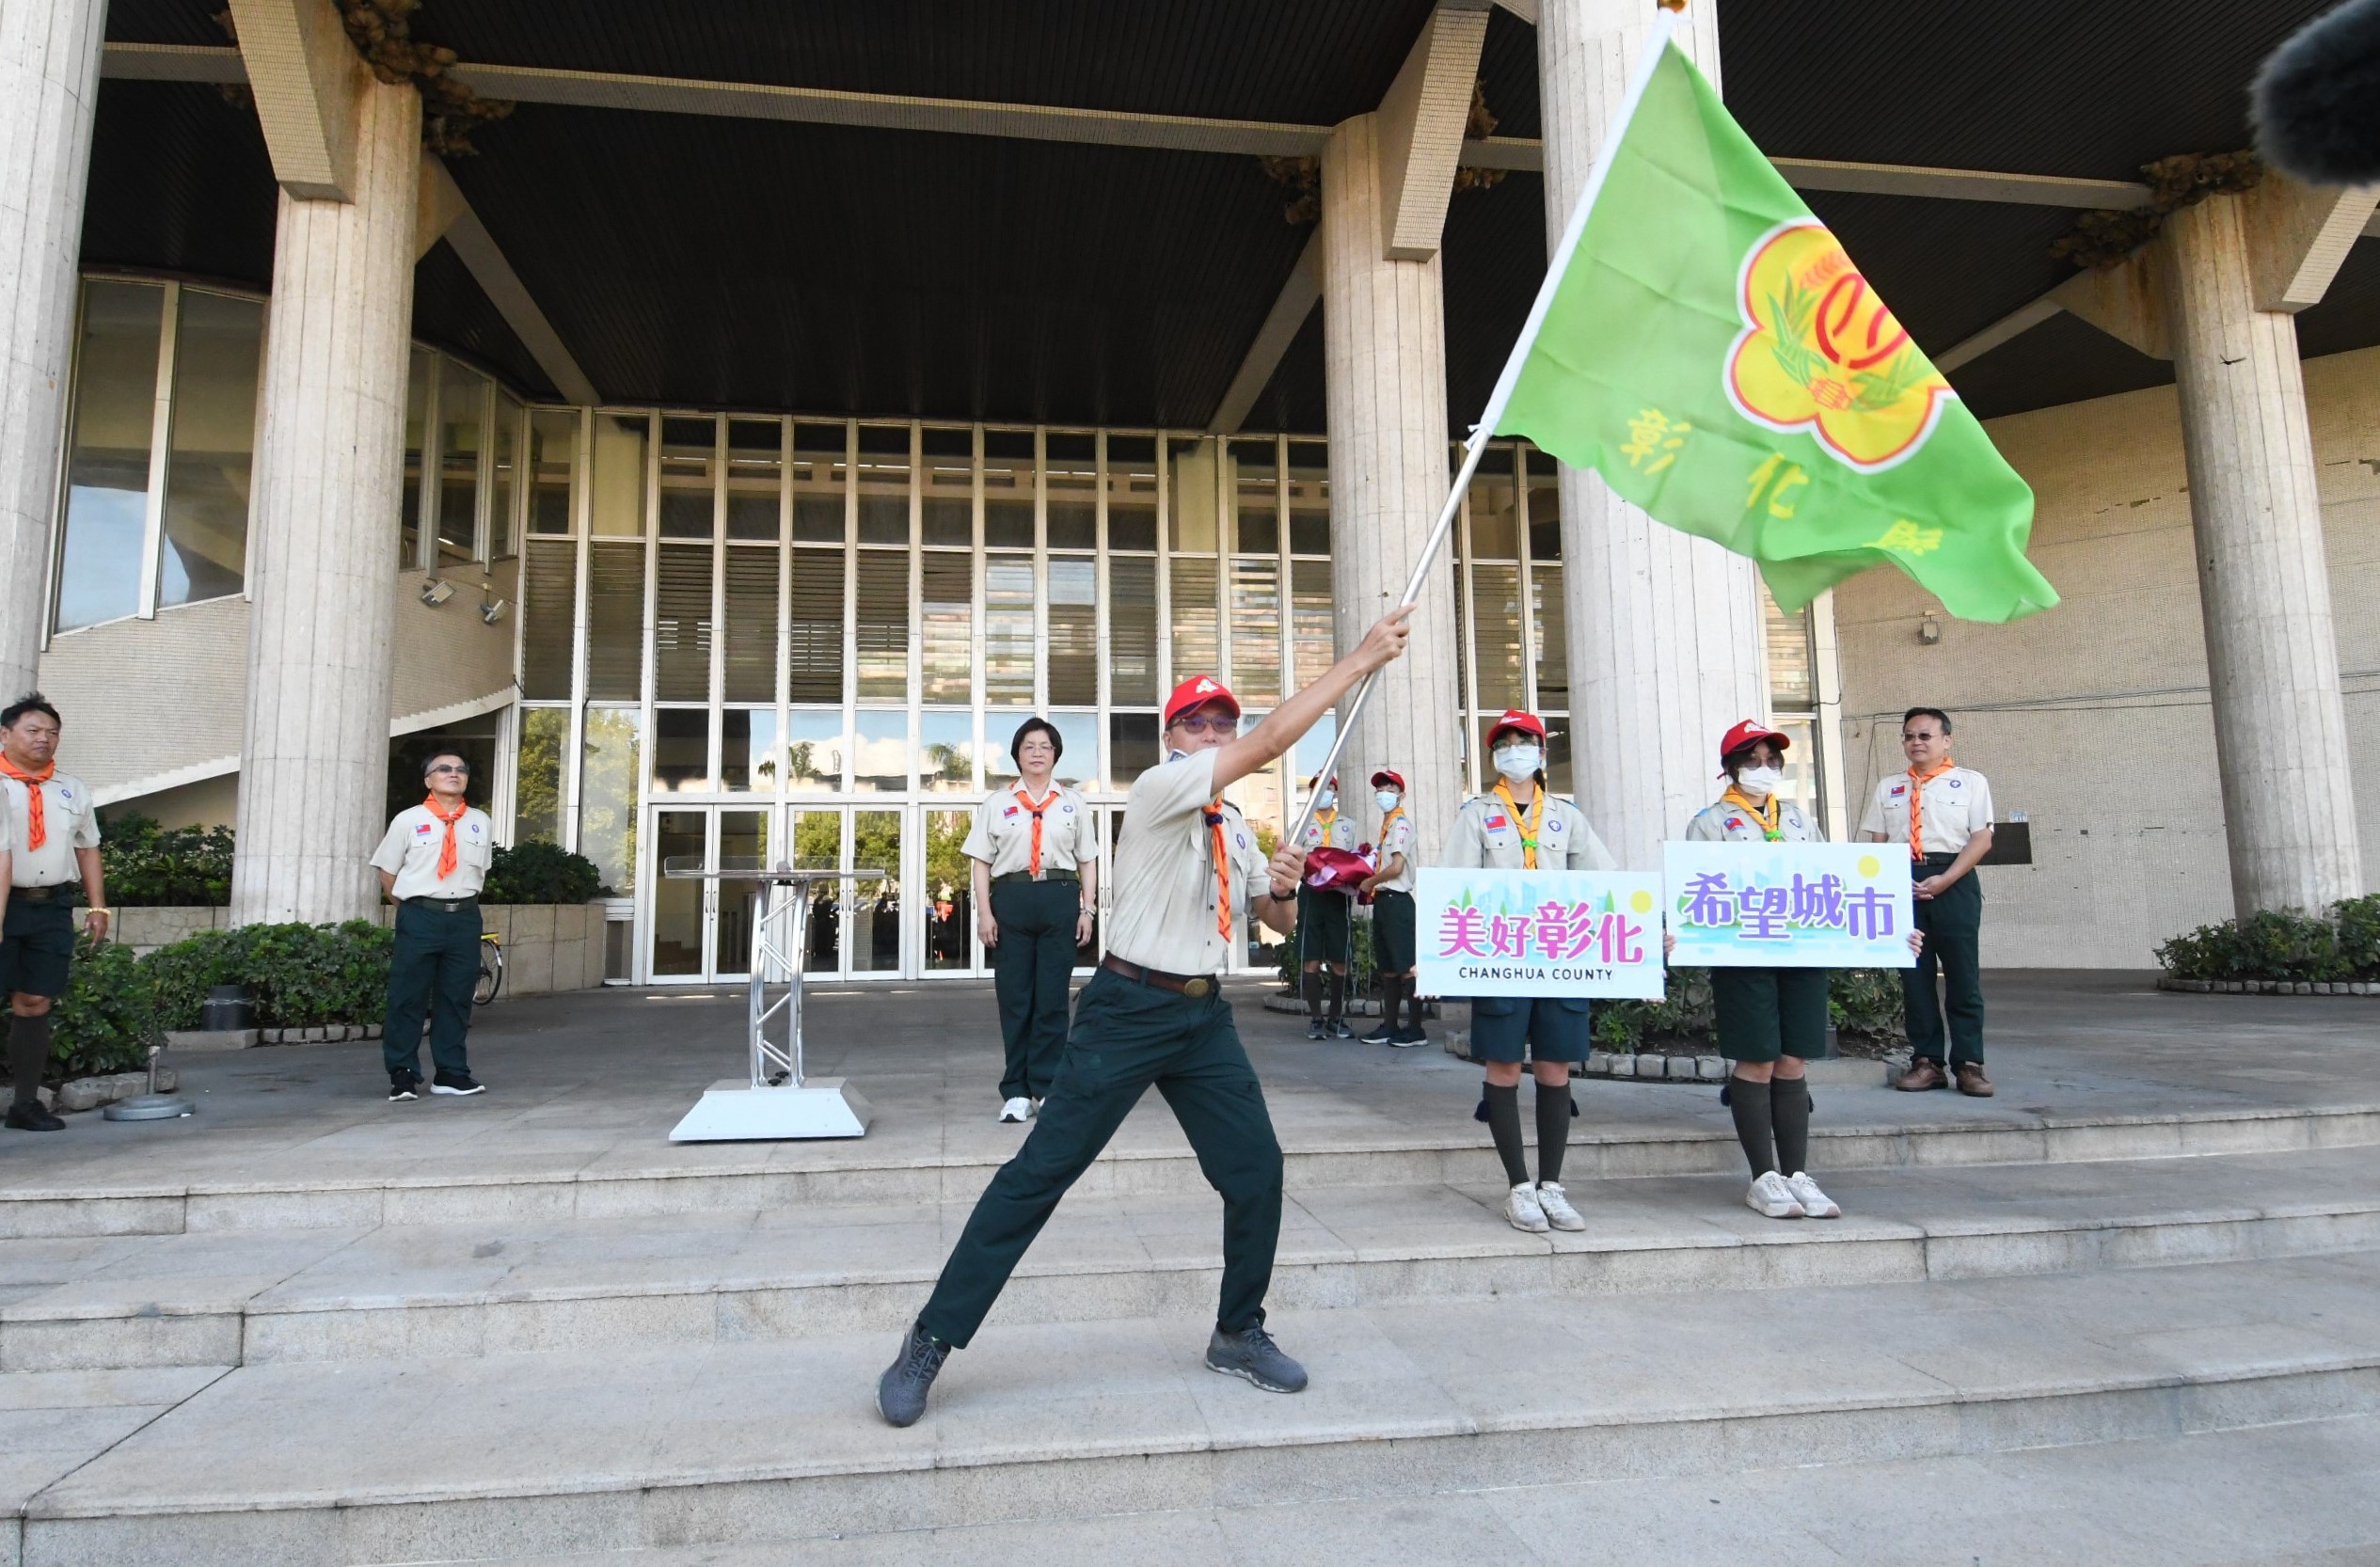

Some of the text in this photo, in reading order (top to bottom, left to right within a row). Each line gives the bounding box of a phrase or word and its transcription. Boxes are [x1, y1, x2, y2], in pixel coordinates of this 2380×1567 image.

[1438, 901, 1643, 963] 美好彰化
[1683, 872, 1896, 940] 希望城市
[1459, 967, 1612, 980] CHANGHUA COUNTY
